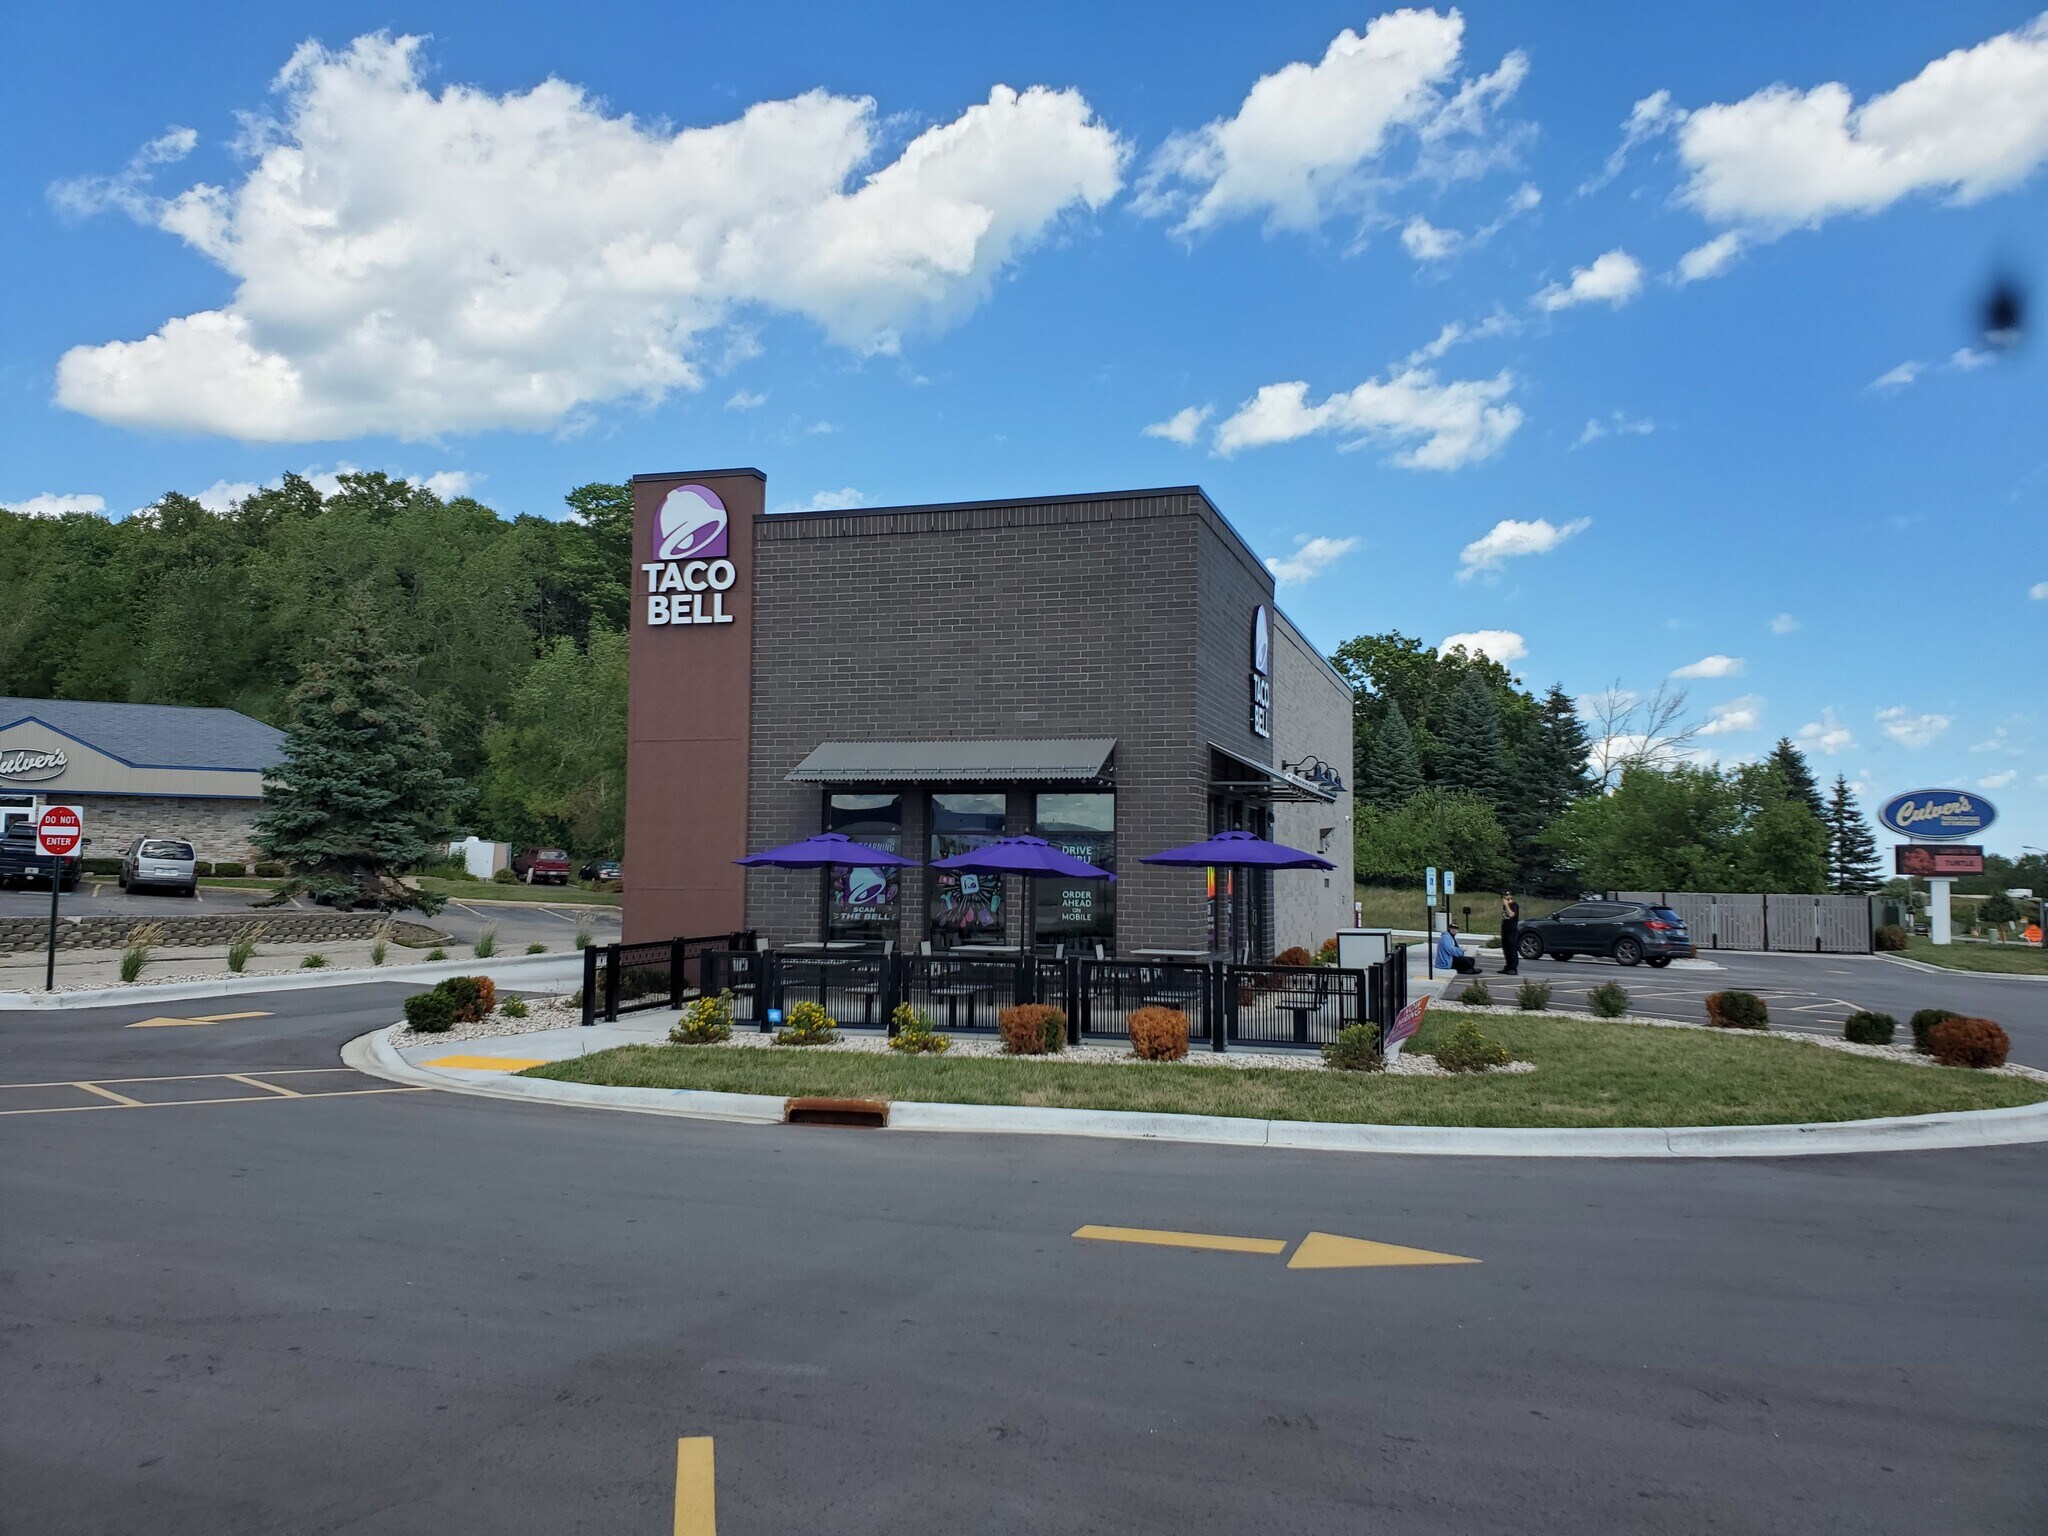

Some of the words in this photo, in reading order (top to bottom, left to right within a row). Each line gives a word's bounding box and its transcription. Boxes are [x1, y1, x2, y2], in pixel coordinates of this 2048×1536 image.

[641, 560, 736, 592] TACO
[648, 593, 733, 625] BELL
[1254, 673, 1269, 709] TACO
[1254, 704, 1269, 739] BELL
[0, 748, 67, 774] ulver's
[1896, 796, 1973, 827] Culver's
[45, 815, 57, 824] DO
[60, 815, 76, 824] NOT
[46, 837, 72, 846] ENTER
[1062, 846, 1092, 855] DRIVE
[1944, 859, 1975, 867] TURTLE
[1062, 890, 1092, 899] ORDER
[1061, 899, 1092, 907] AHEAD
[840, 912, 861, 920] THE
[864, 912, 890, 921] BELL
[1061, 913, 1092, 921] MOBILE
